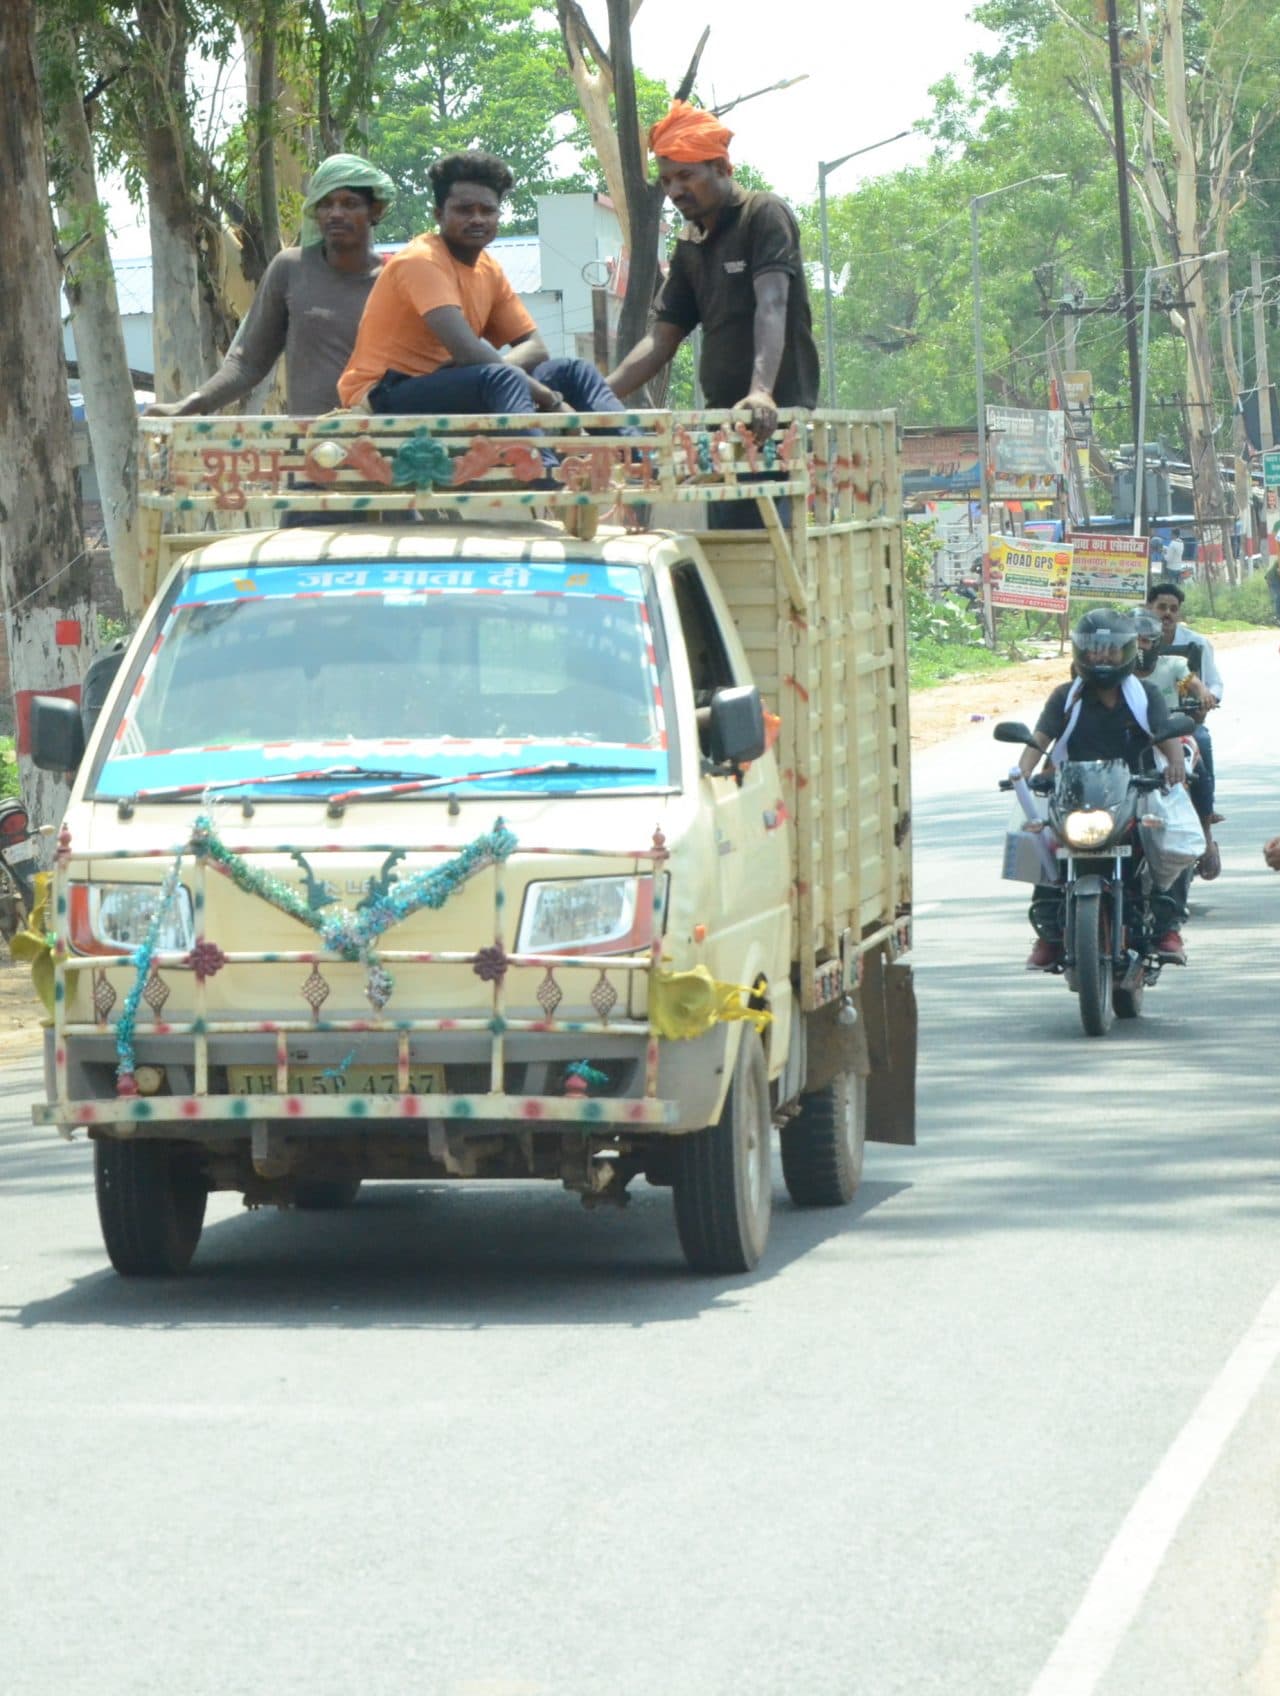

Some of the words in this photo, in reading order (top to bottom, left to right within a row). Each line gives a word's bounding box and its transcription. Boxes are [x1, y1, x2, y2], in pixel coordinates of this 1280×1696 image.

[201, 447, 282, 510] शुभ
[1007, 552, 1032, 567] ROAD
[1035, 556, 1054, 569] GPS
[298, 570, 370, 588] जय
[383, 570, 474, 587] माता
[488, 566, 533, 587] दी
[239, 1075, 273, 1094] JH
